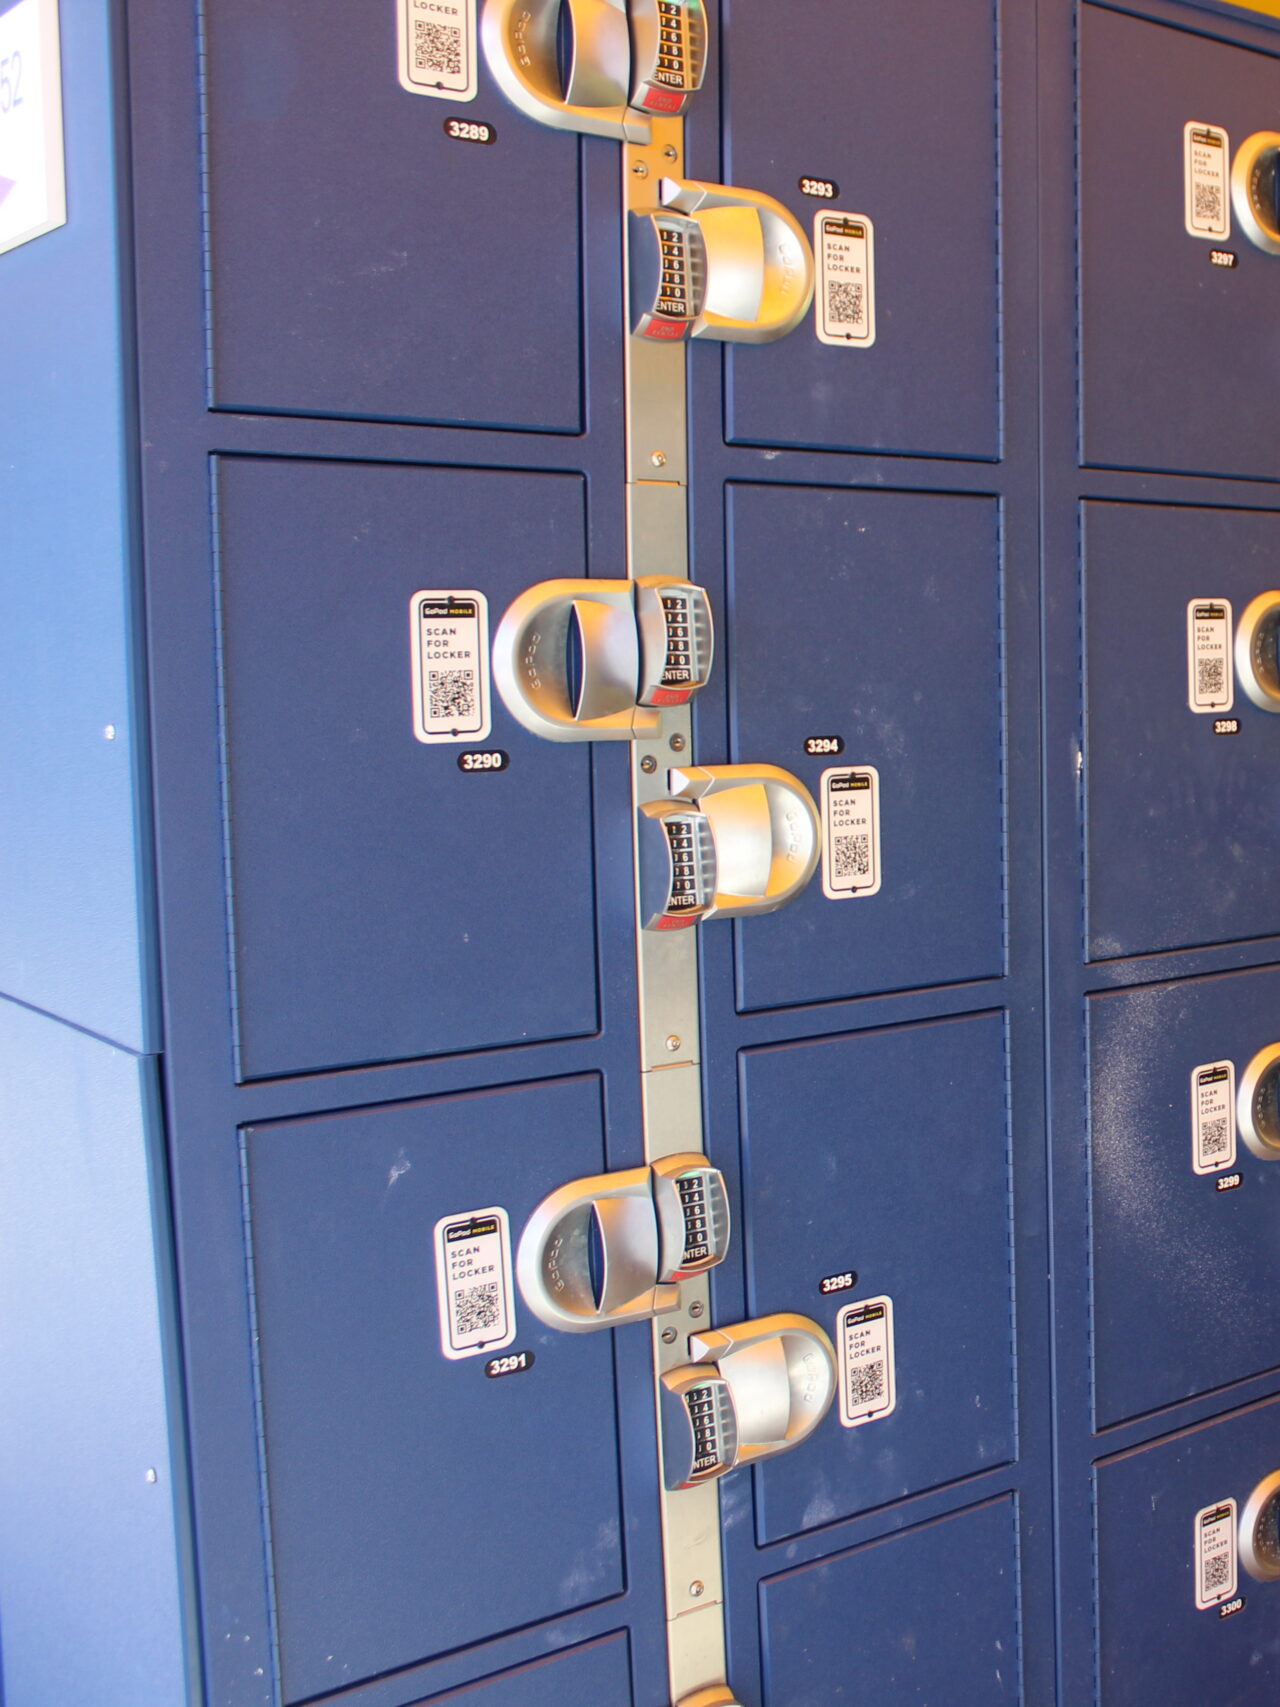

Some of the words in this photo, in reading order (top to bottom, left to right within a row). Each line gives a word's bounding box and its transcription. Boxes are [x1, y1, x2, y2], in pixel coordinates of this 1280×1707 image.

[413, 1, 459, 16] LOCKER
[449, 121, 490, 142] 3289
[801, 179, 833, 198] 3293
[827, 243, 850, 252] SCAN
[827, 253, 844, 261] FOR
[1211, 251, 1234, 267] 3297
[827, 264, 861, 273] LOCKER
[426, 628, 457, 636] SCAN
[426, 640, 449, 648] FOR
[427, 651, 471, 660] LOCKER
[1215, 720, 1237, 734] 3298
[807, 738, 838, 753] 3294
[462, 753, 502, 769] 3290
[833, 799, 856, 807] SCAN
[833, 809, 850, 817] FOR
[833, 818, 867, 827] LOCKER
[1218, 1174, 1240, 1190] 3299
[451, 1246, 480, 1259] SCAN
[451, 1258, 473, 1270] FOR
[452, 1265, 495, 1281] LOCKER
[822, 1273, 853, 1292] 3295
[848, 1330, 871, 1342] SCAN
[848, 1340, 866, 1351] FOR
[849, 1345, 881, 1360] LOCKER
[490, 1353, 527, 1375] 3291
[1220, 1598, 1242, 1616] 3300
